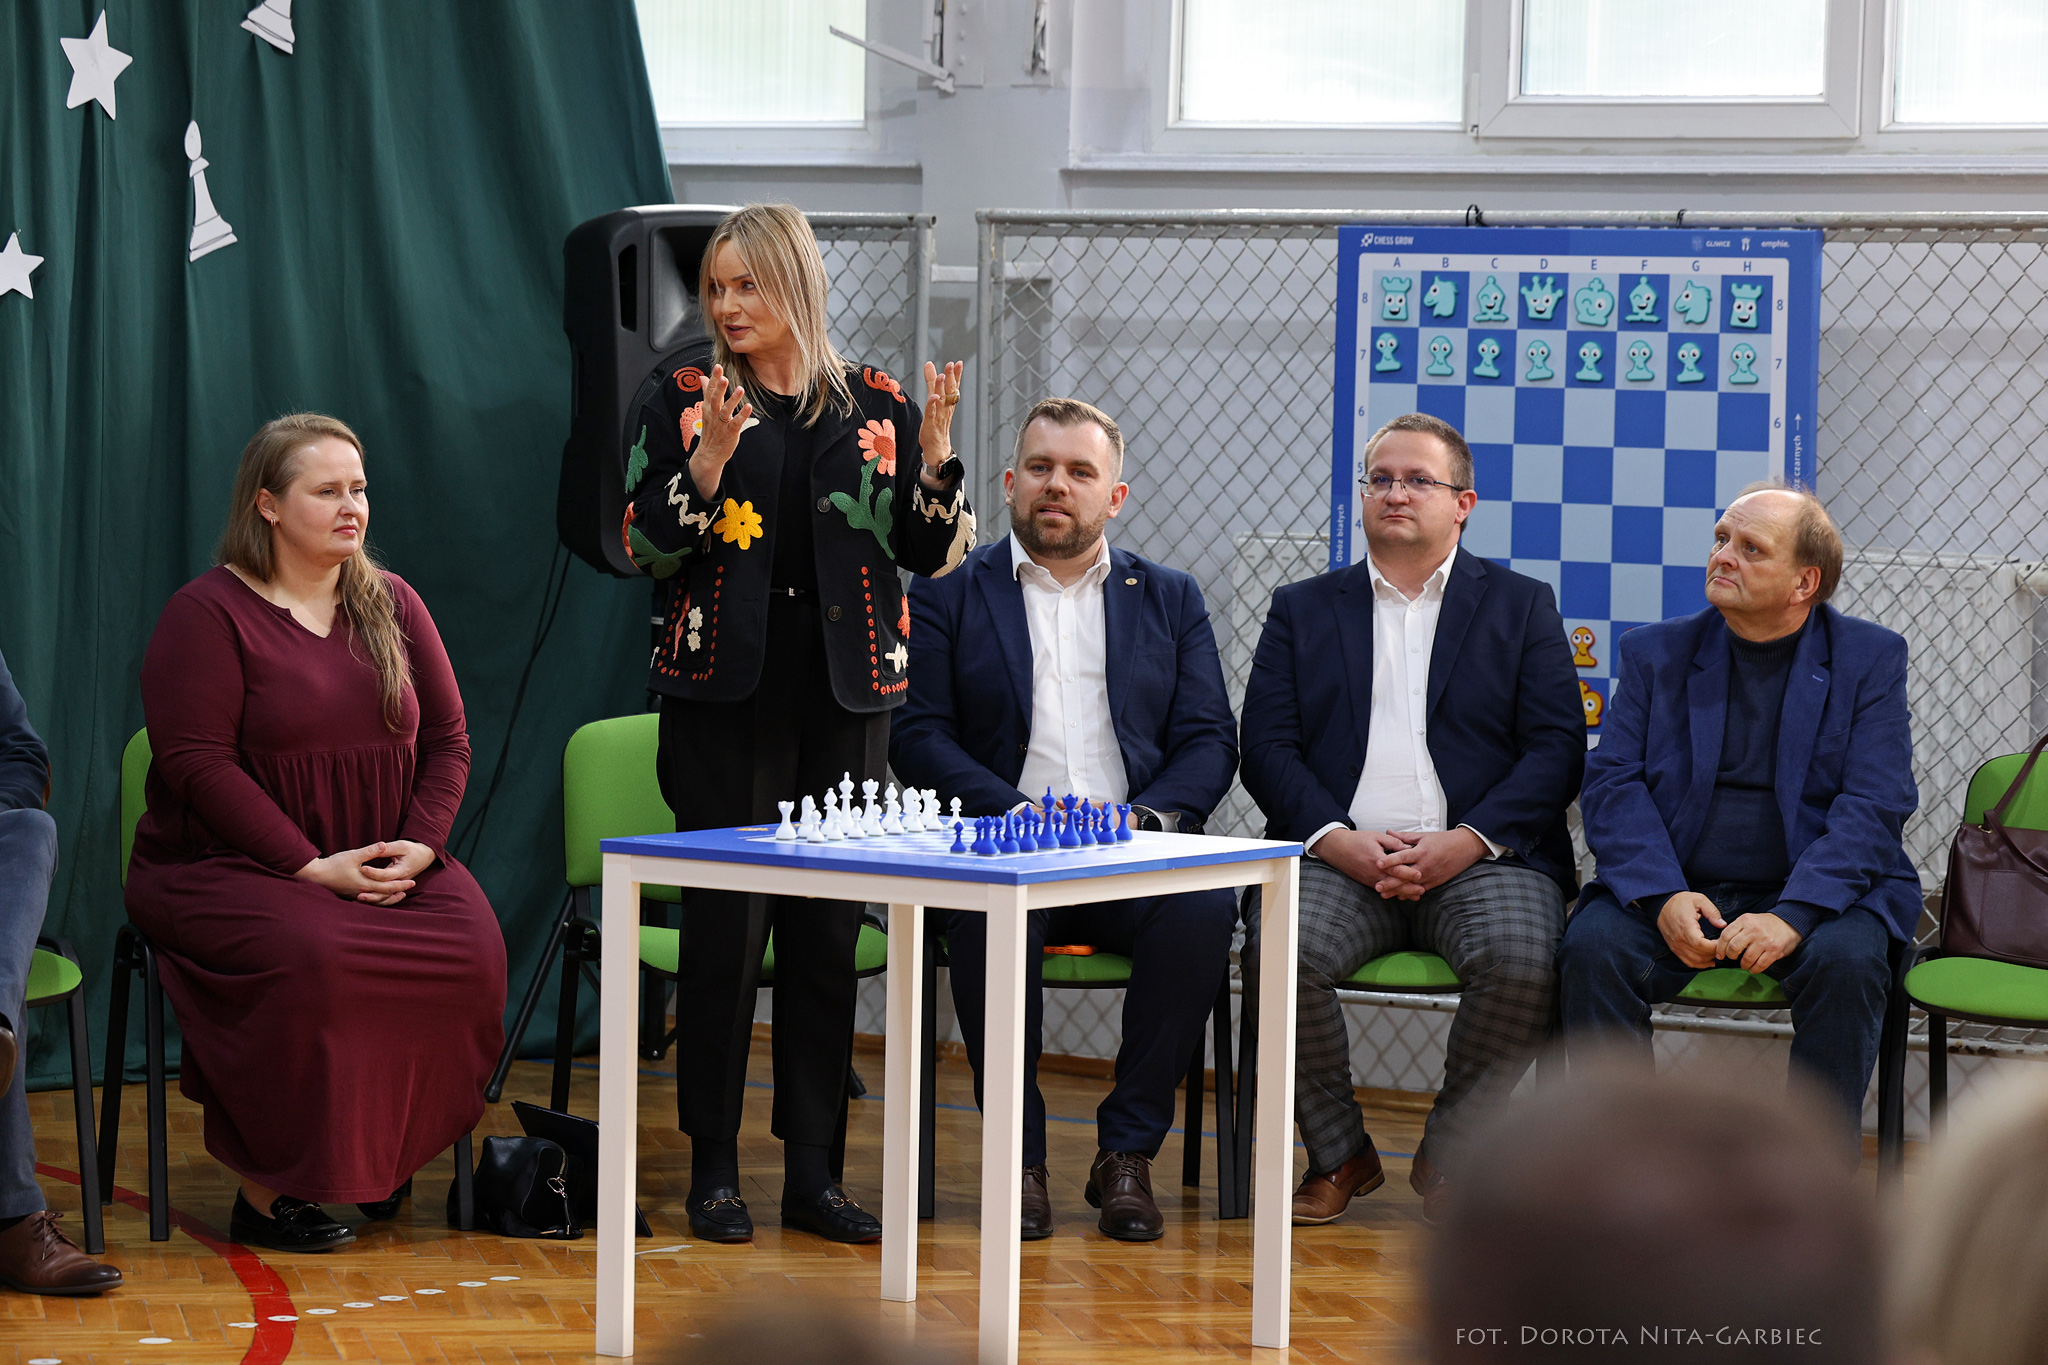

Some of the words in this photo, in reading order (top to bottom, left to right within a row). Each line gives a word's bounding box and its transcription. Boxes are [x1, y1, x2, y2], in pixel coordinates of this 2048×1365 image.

[1374, 235, 1394, 246] CHESS
[1706, 240, 1731, 248] GLIWICE
[1393, 257, 1401, 268] A
[1442, 257, 1450, 268] B
[1491, 258, 1499, 269] C
[1540, 258, 1548, 269] D
[1591, 259, 1598, 270] E
[1641, 260, 1648, 271] F
[1692, 260, 1700, 272] G
[1743, 261, 1752, 272] H
[1362, 292, 1368, 304] 8
[1776, 299, 1783, 311] 8
[1360, 349, 1367, 360] 7
[1775, 358, 1782, 370] 7
[1358, 406, 1365, 417] 6
[1774, 417, 1781, 429] 6
[1793, 435, 1803, 477] czarnych
[1357, 462, 1363, 473] 5
[1337, 503, 1345, 537] białych
[1355, 519, 1362, 530] 4
[1336, 539, 1344, 562] Obóz
